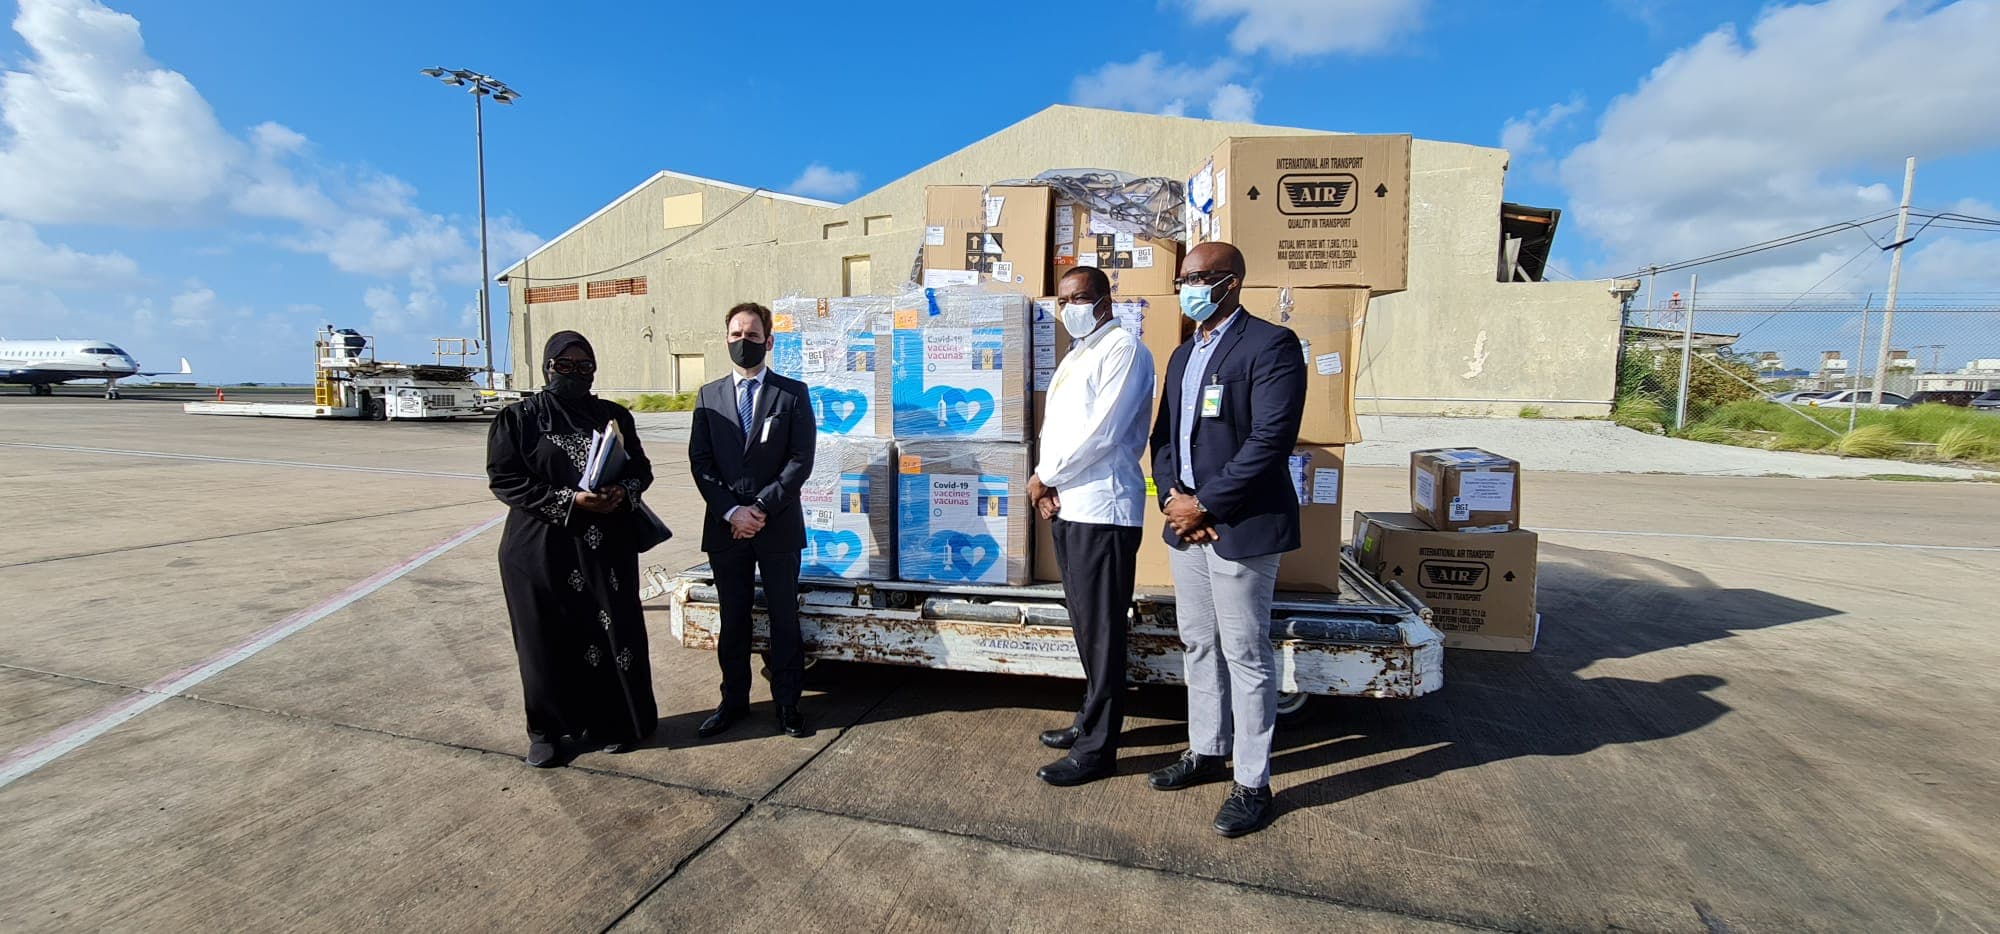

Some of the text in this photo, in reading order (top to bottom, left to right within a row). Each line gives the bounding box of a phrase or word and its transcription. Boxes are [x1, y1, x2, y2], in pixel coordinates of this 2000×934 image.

[1276, 157, 1363, 169] INTERNATIONAL AIR TRANSPORT
[1300, 186, 1337, 202] AIR
[1288, 218, 1351, 229] QUALITY IN TRANSPORT
[927, 335, 963, 345] Covid-19
[927, 352, 963, 360] vacunas
[933, 481, 969, 490] Covid-19
[933, 490, 971, 498] vaccines
[933, 498, 969, 506] vacunas
[1455, 503, 1469, 511] BGI
[818, 510, 832, 519] BGI
[1438, 569, 1470, 581] AIR
